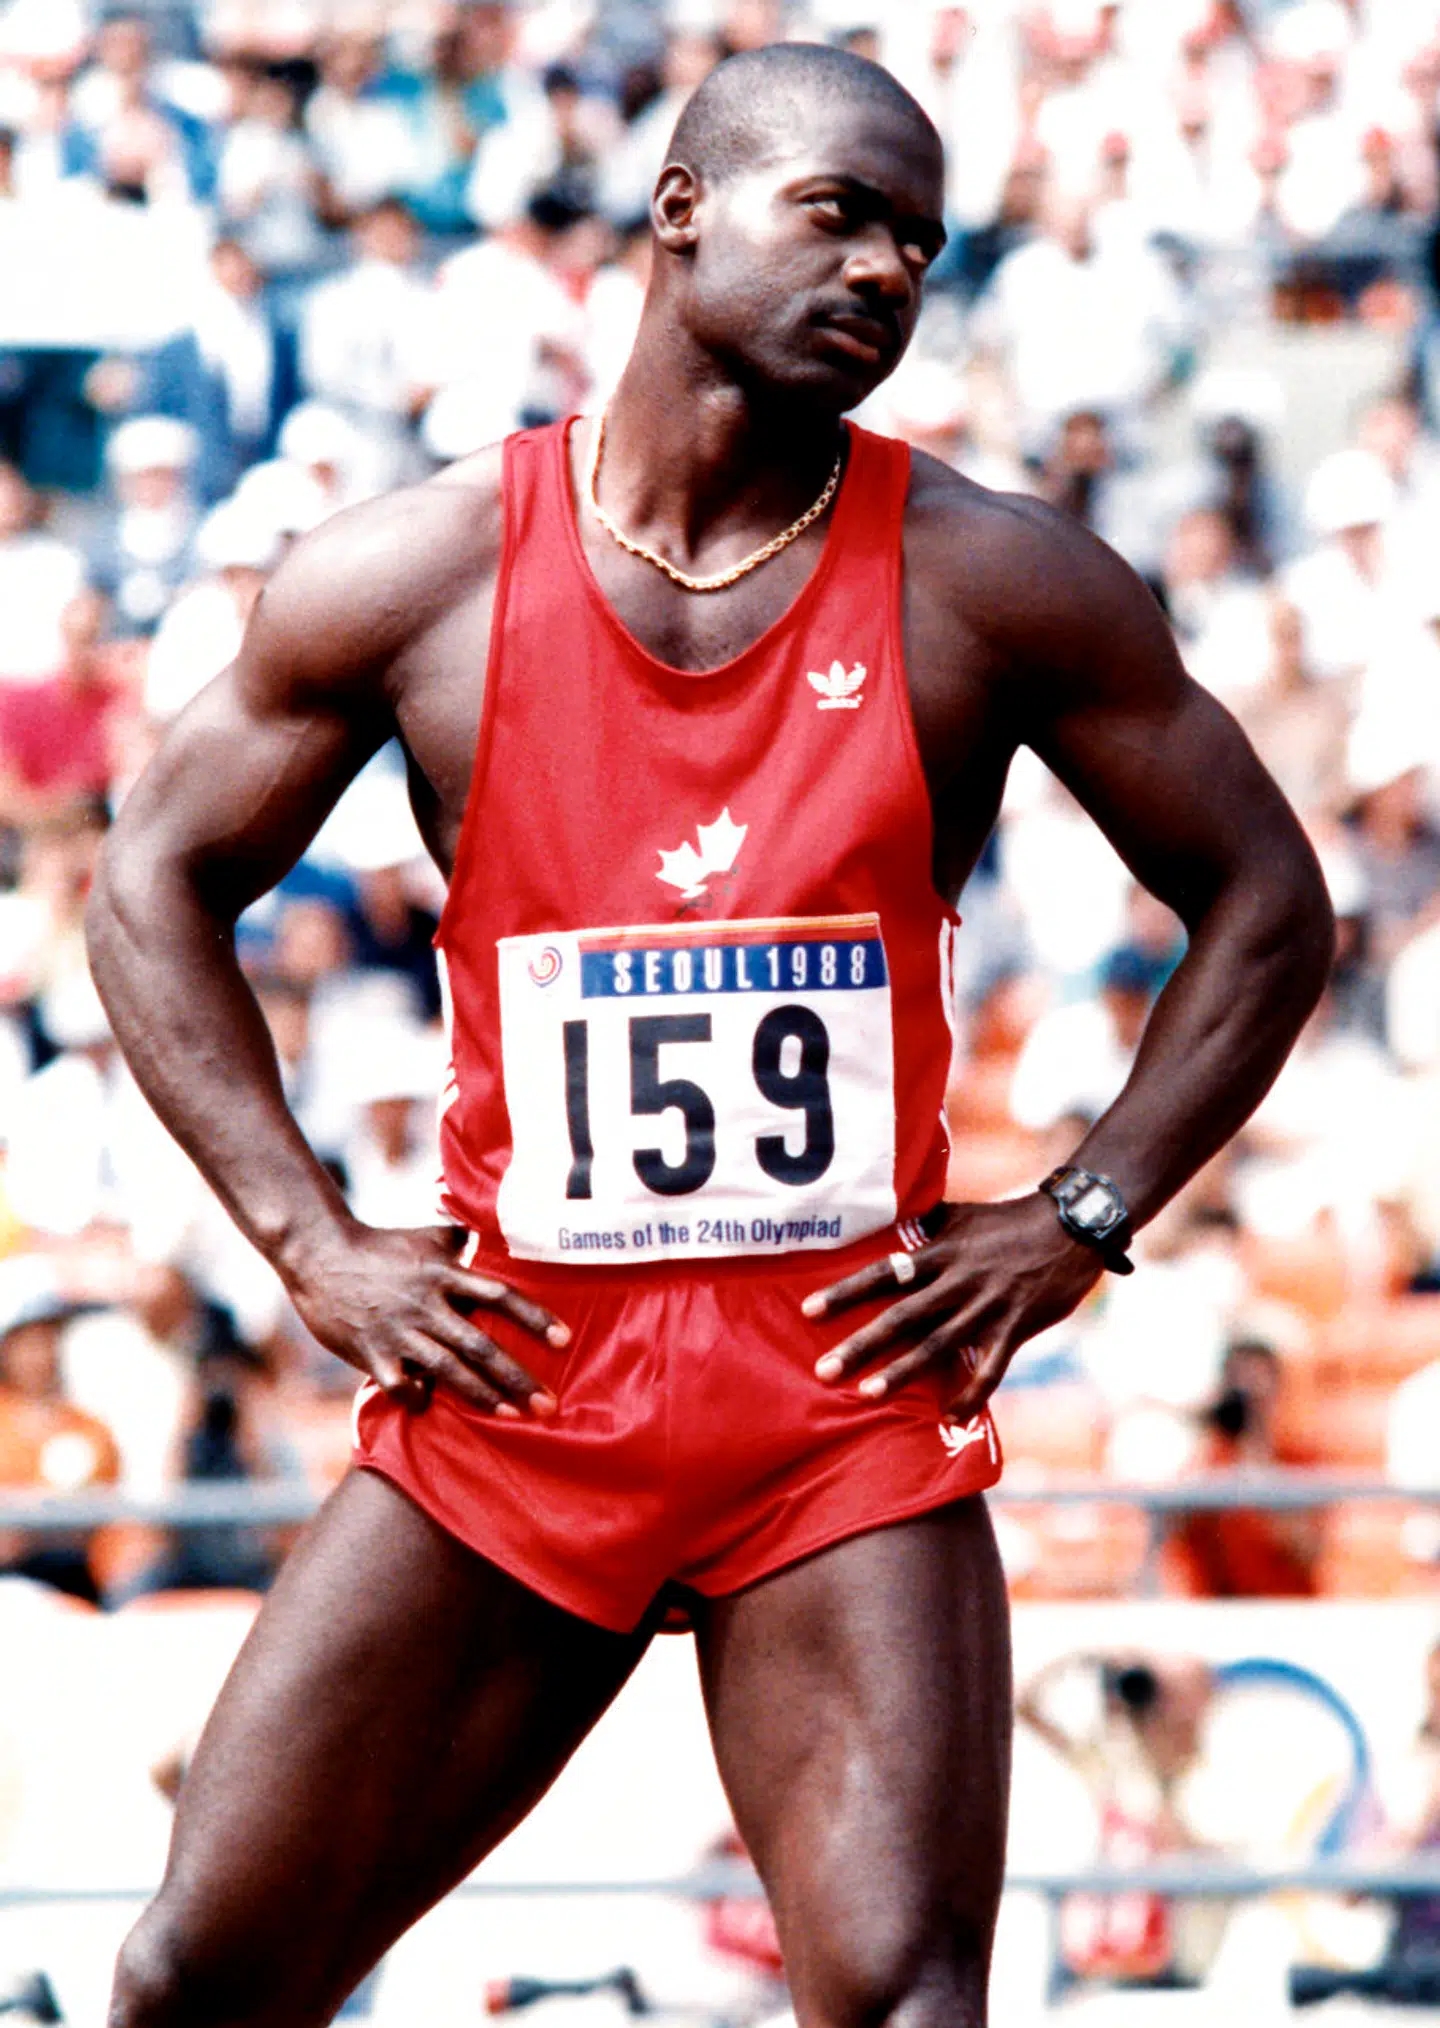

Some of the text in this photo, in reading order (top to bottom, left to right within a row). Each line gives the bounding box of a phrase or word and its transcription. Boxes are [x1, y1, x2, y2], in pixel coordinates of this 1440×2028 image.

[613, 944, 867, 994] SEOUL 1988
[562, 1004, 835, 1200] 159
[558, 1215, 842, 1250] Games of the 24th Olympiad
